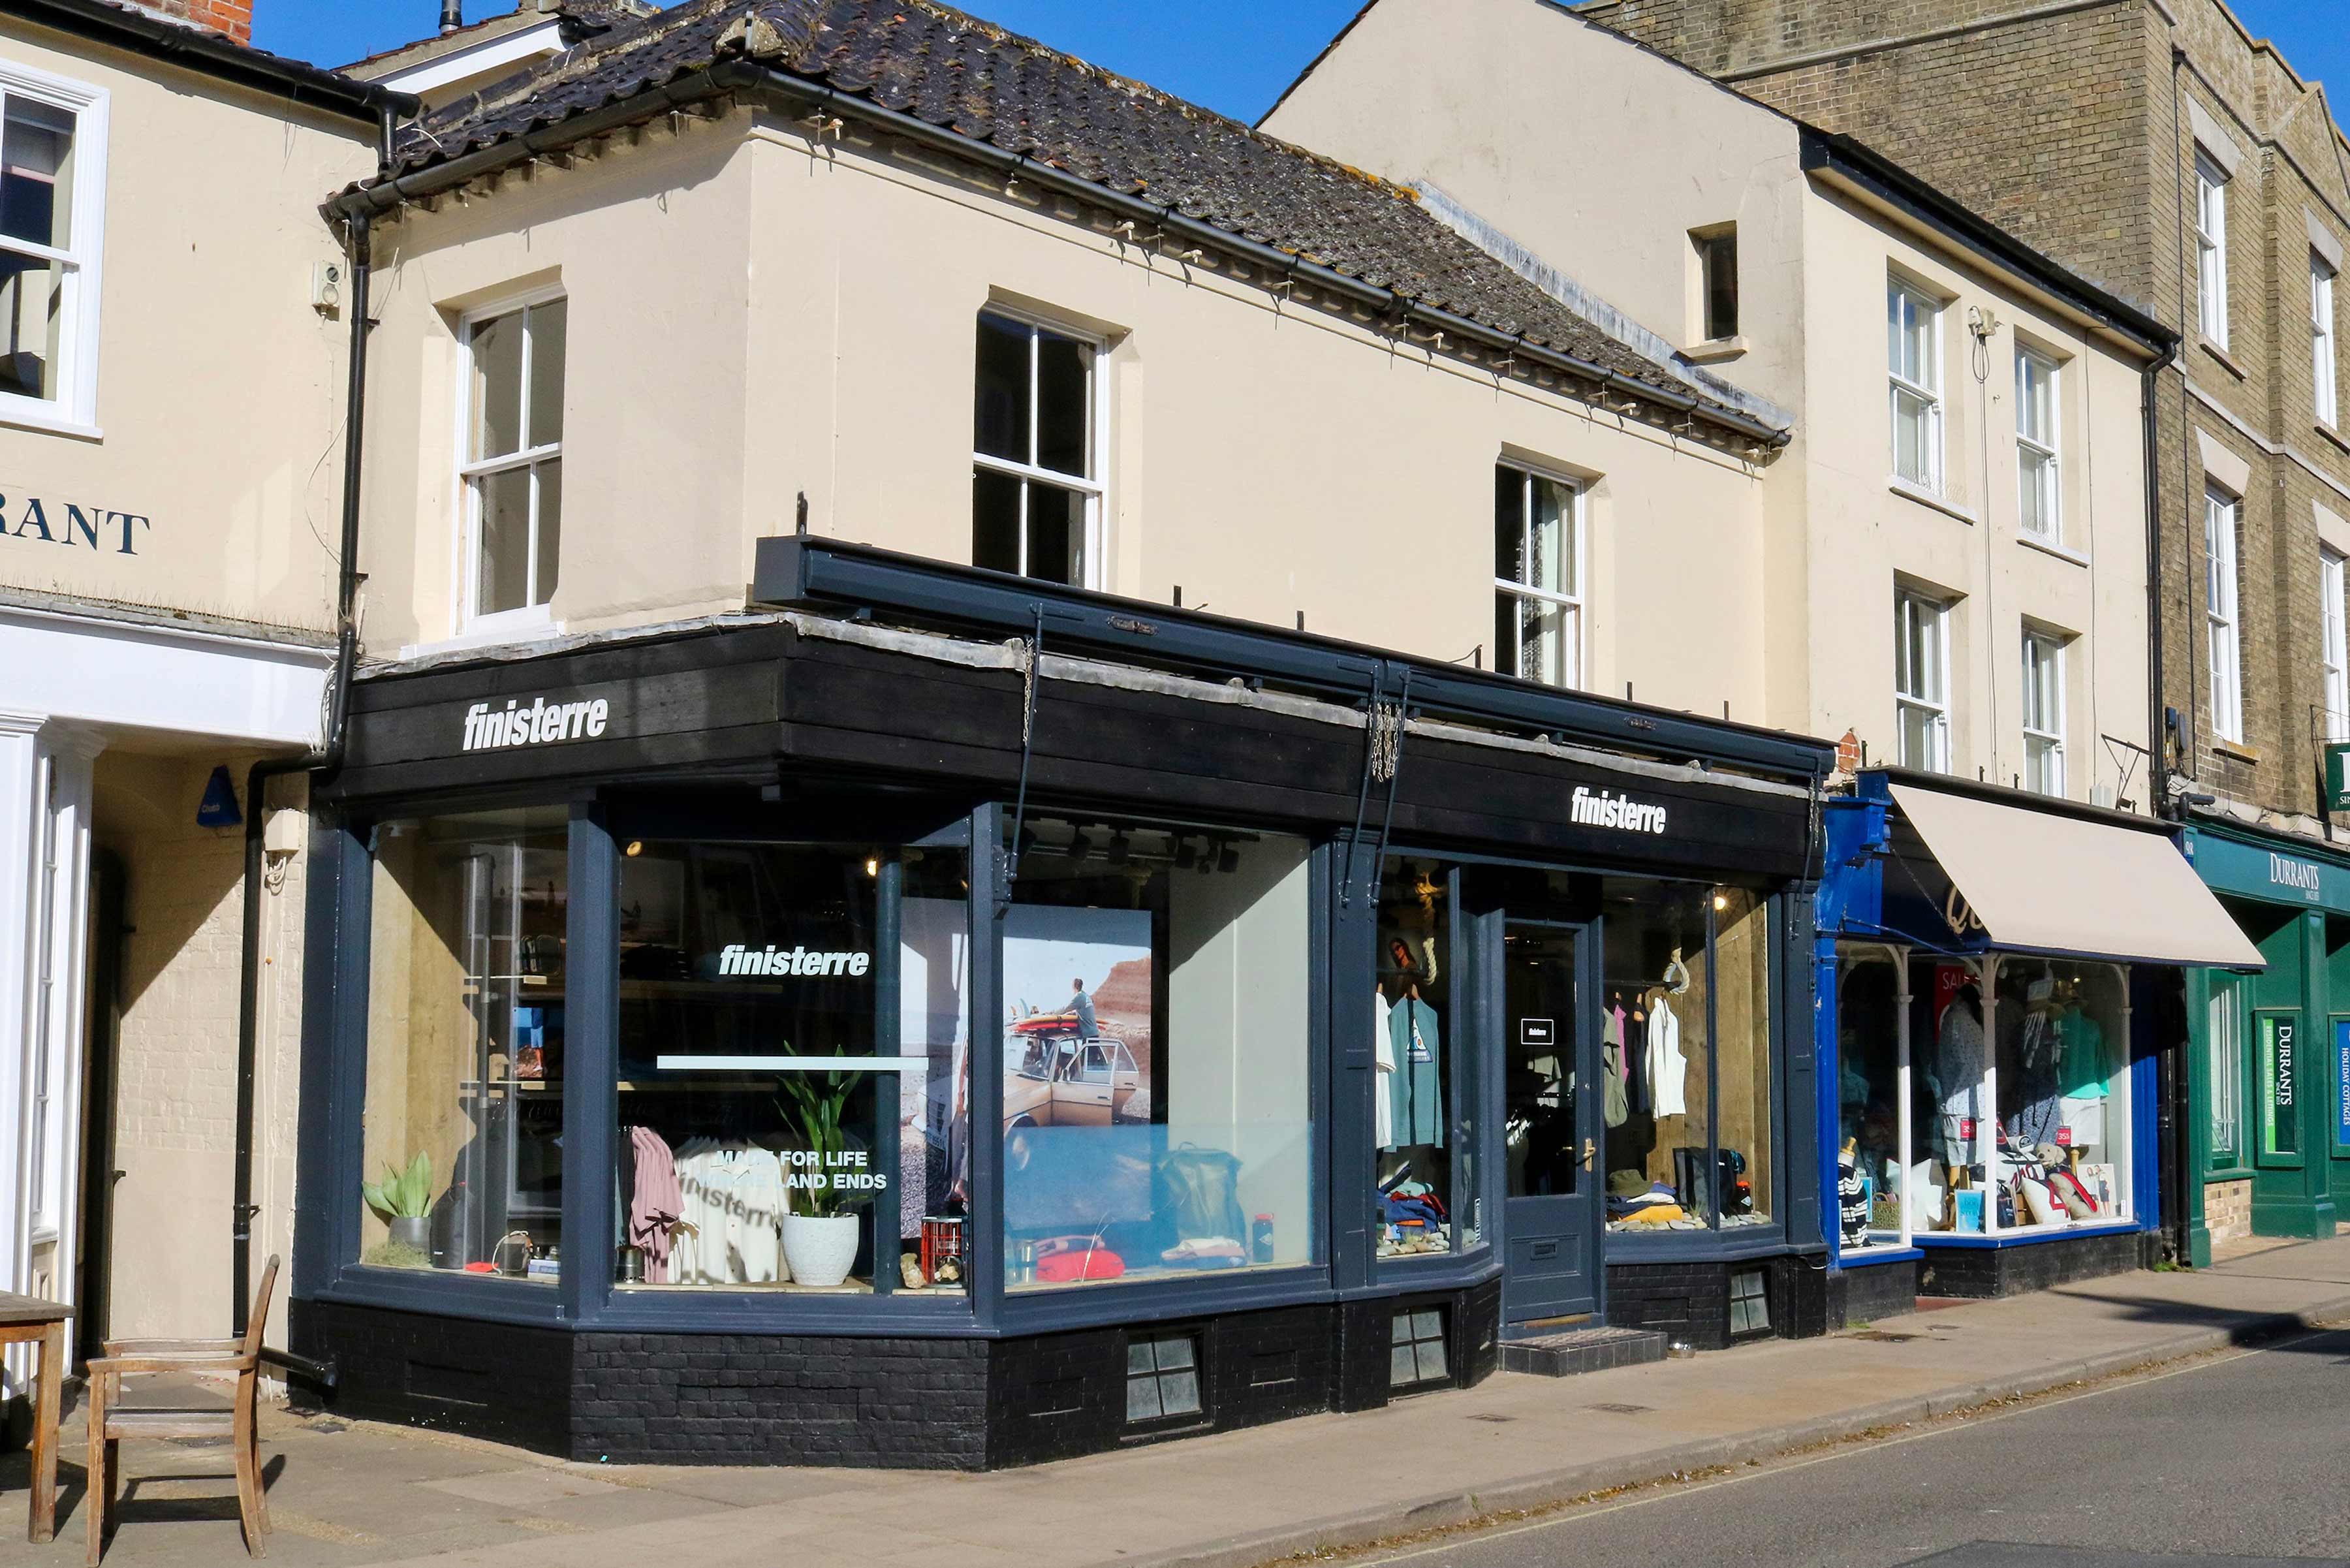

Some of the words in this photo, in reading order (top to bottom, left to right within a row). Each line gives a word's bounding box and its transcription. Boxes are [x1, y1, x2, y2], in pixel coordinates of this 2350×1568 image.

[0, 493, 150, 555] ANT
[463, 697, 608, 751] finisterre
[1571, 786, 1667, 834] finisterre
[719, 945, 870, 977] finisterre
[2279, 1026, 2292, 1106] DURRANTS
[780, 1151, 819, 1167] FOR
[826, 1151, 868, 1167] LIFE
[833, 1174, 887, 1189] ENDS
